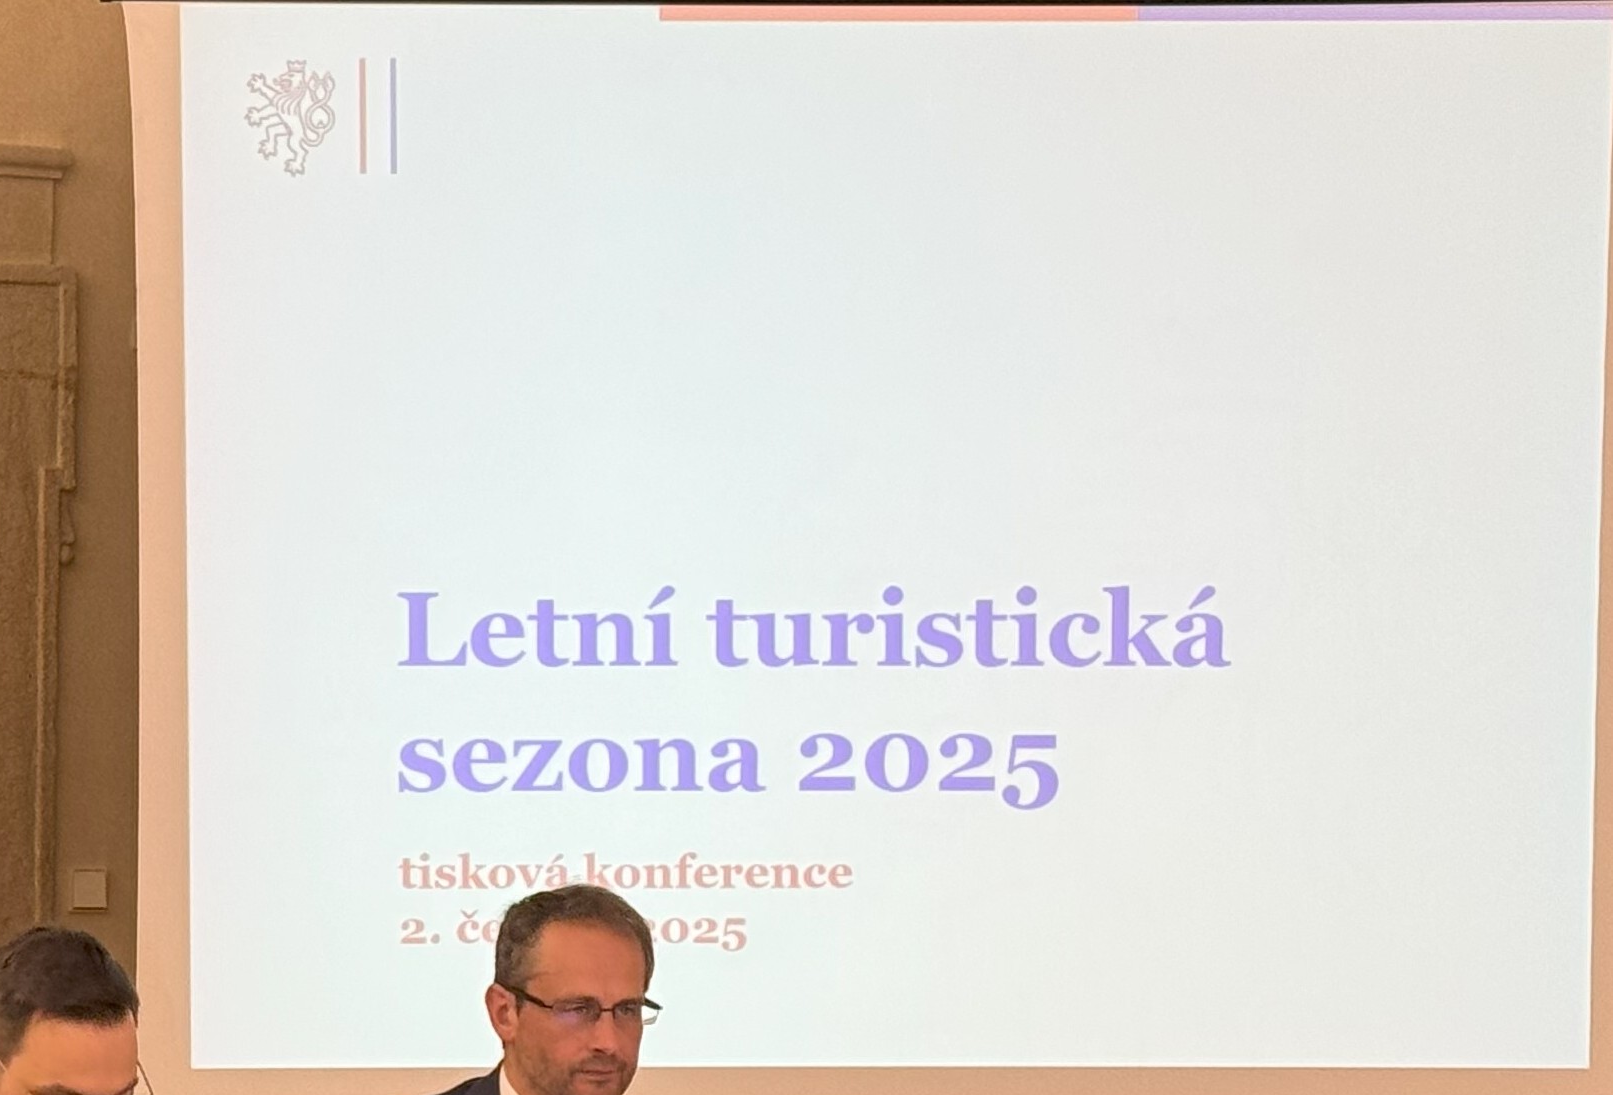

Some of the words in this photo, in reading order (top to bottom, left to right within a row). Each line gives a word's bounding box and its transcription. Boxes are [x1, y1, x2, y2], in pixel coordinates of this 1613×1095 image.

[396, 585, 679, 668] Letní
[706, 585, 1232, 669] turistická
[396, 735, 767, 794] sezona
[797, 732, 1060, 811] 2025
[398, 852, 568, 890] tisková
[584, 851, 854, 890] konference
[399, 917, 441, 945] 2.
[651, 916, 748, 953] 025
